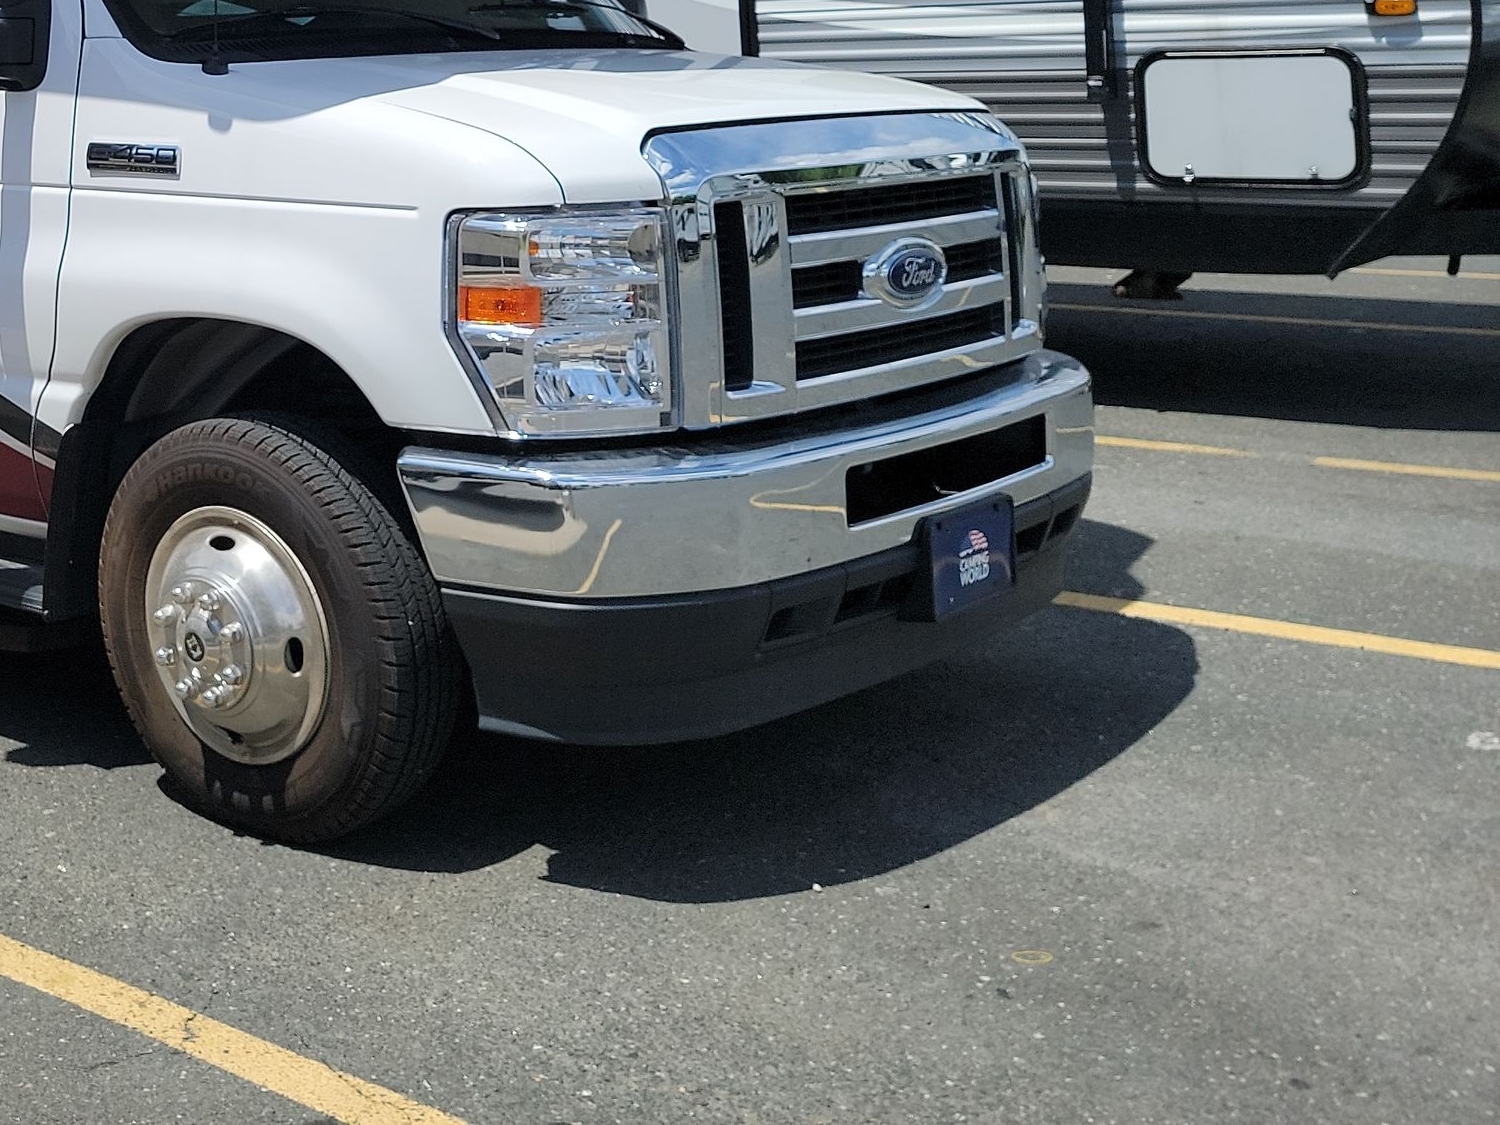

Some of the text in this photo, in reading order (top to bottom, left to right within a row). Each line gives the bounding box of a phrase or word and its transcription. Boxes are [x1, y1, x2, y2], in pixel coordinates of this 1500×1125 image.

[902, 257, 936, 288] Ford
[959, 550, 990, 572] CAMPING
[959, 562, 990, 588] WORLD
